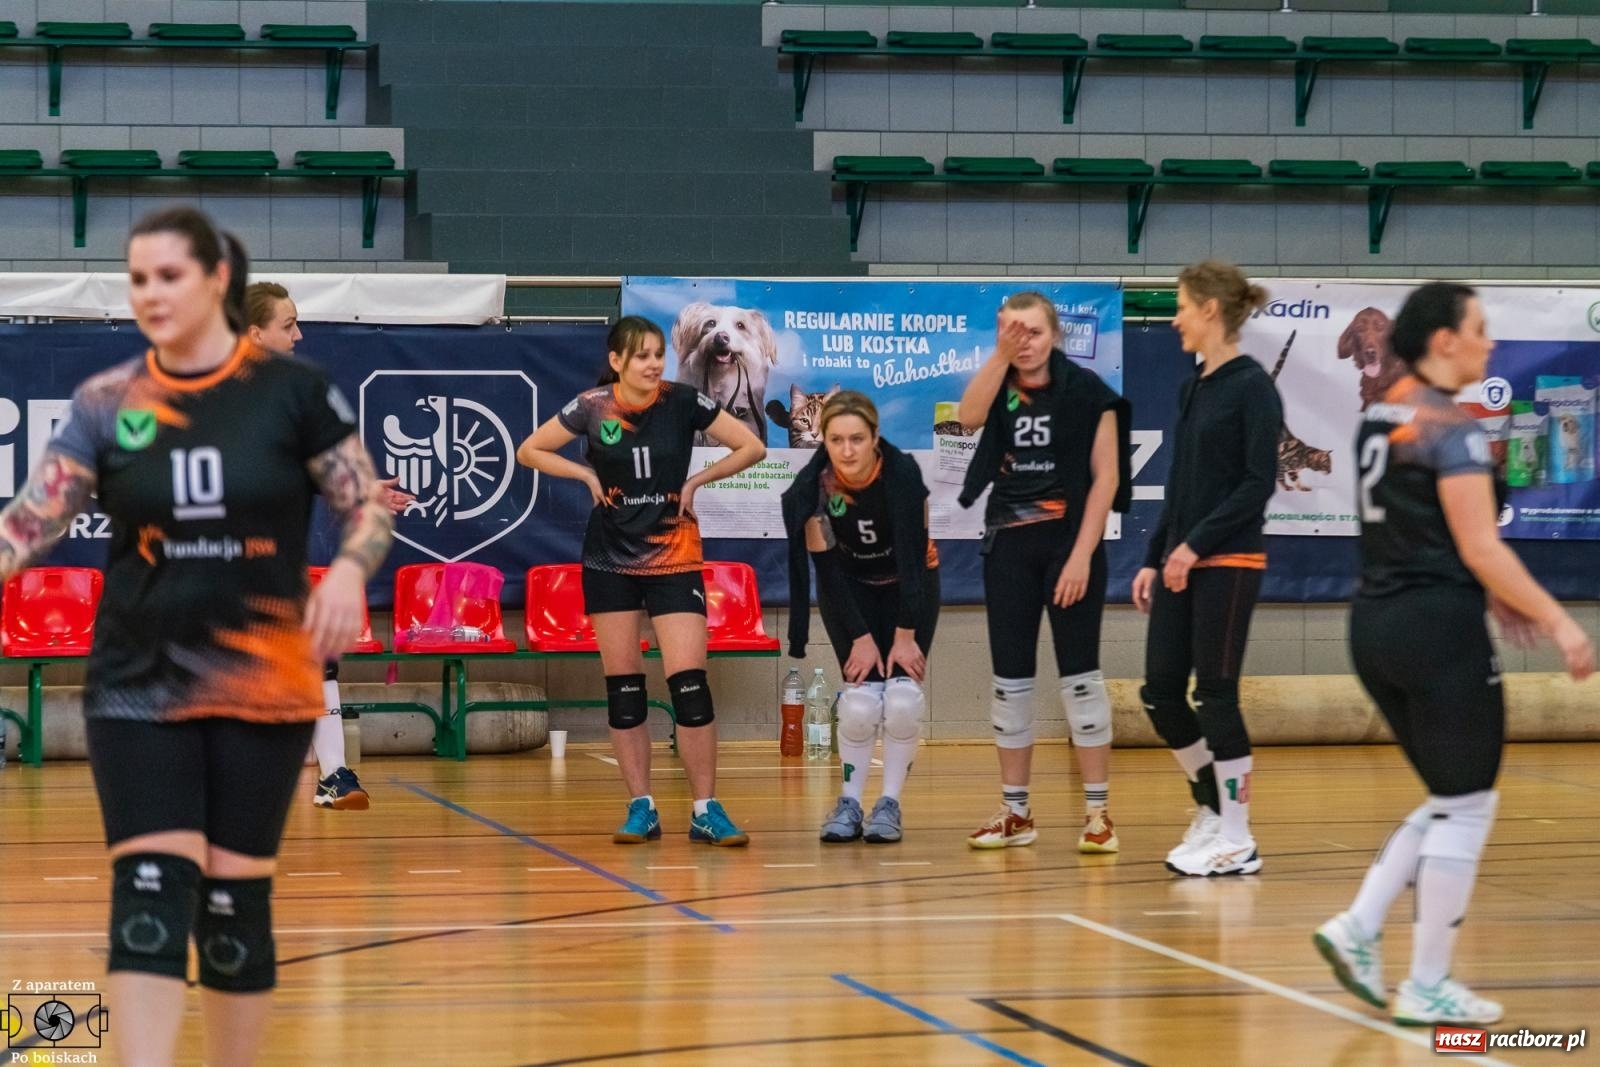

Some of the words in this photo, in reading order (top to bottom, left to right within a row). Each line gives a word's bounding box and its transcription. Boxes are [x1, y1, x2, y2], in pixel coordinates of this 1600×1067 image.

[785, 311, 895, 332] REGULARNIE
[901, 314, 967, 333] KROPLE
[822, 334, 854, 353] LUB
[861, 335, 930, 354] KOSTKA
[803, 354, 808, 367] i
[812, 356, 852, 368] robaki
[856, 357, 870, 369] to
[873, 345, 981, 388] błahostka!
[1014, 415, 1051, 447] 25
[940, 438, 977, 450] Dronspot
[632, 446, 651, 479] 11
[170, 446, 224, 506] 10
[719, 481, 751, 491] zeskanuj
[754, 481, 770, 489] kod.
[623, 493, 665, 506] Fundacja
[69, 512, 113, 539] RZ
[1339, 514, 1361, 522] STA
[858, 519, 878, 544] 5
